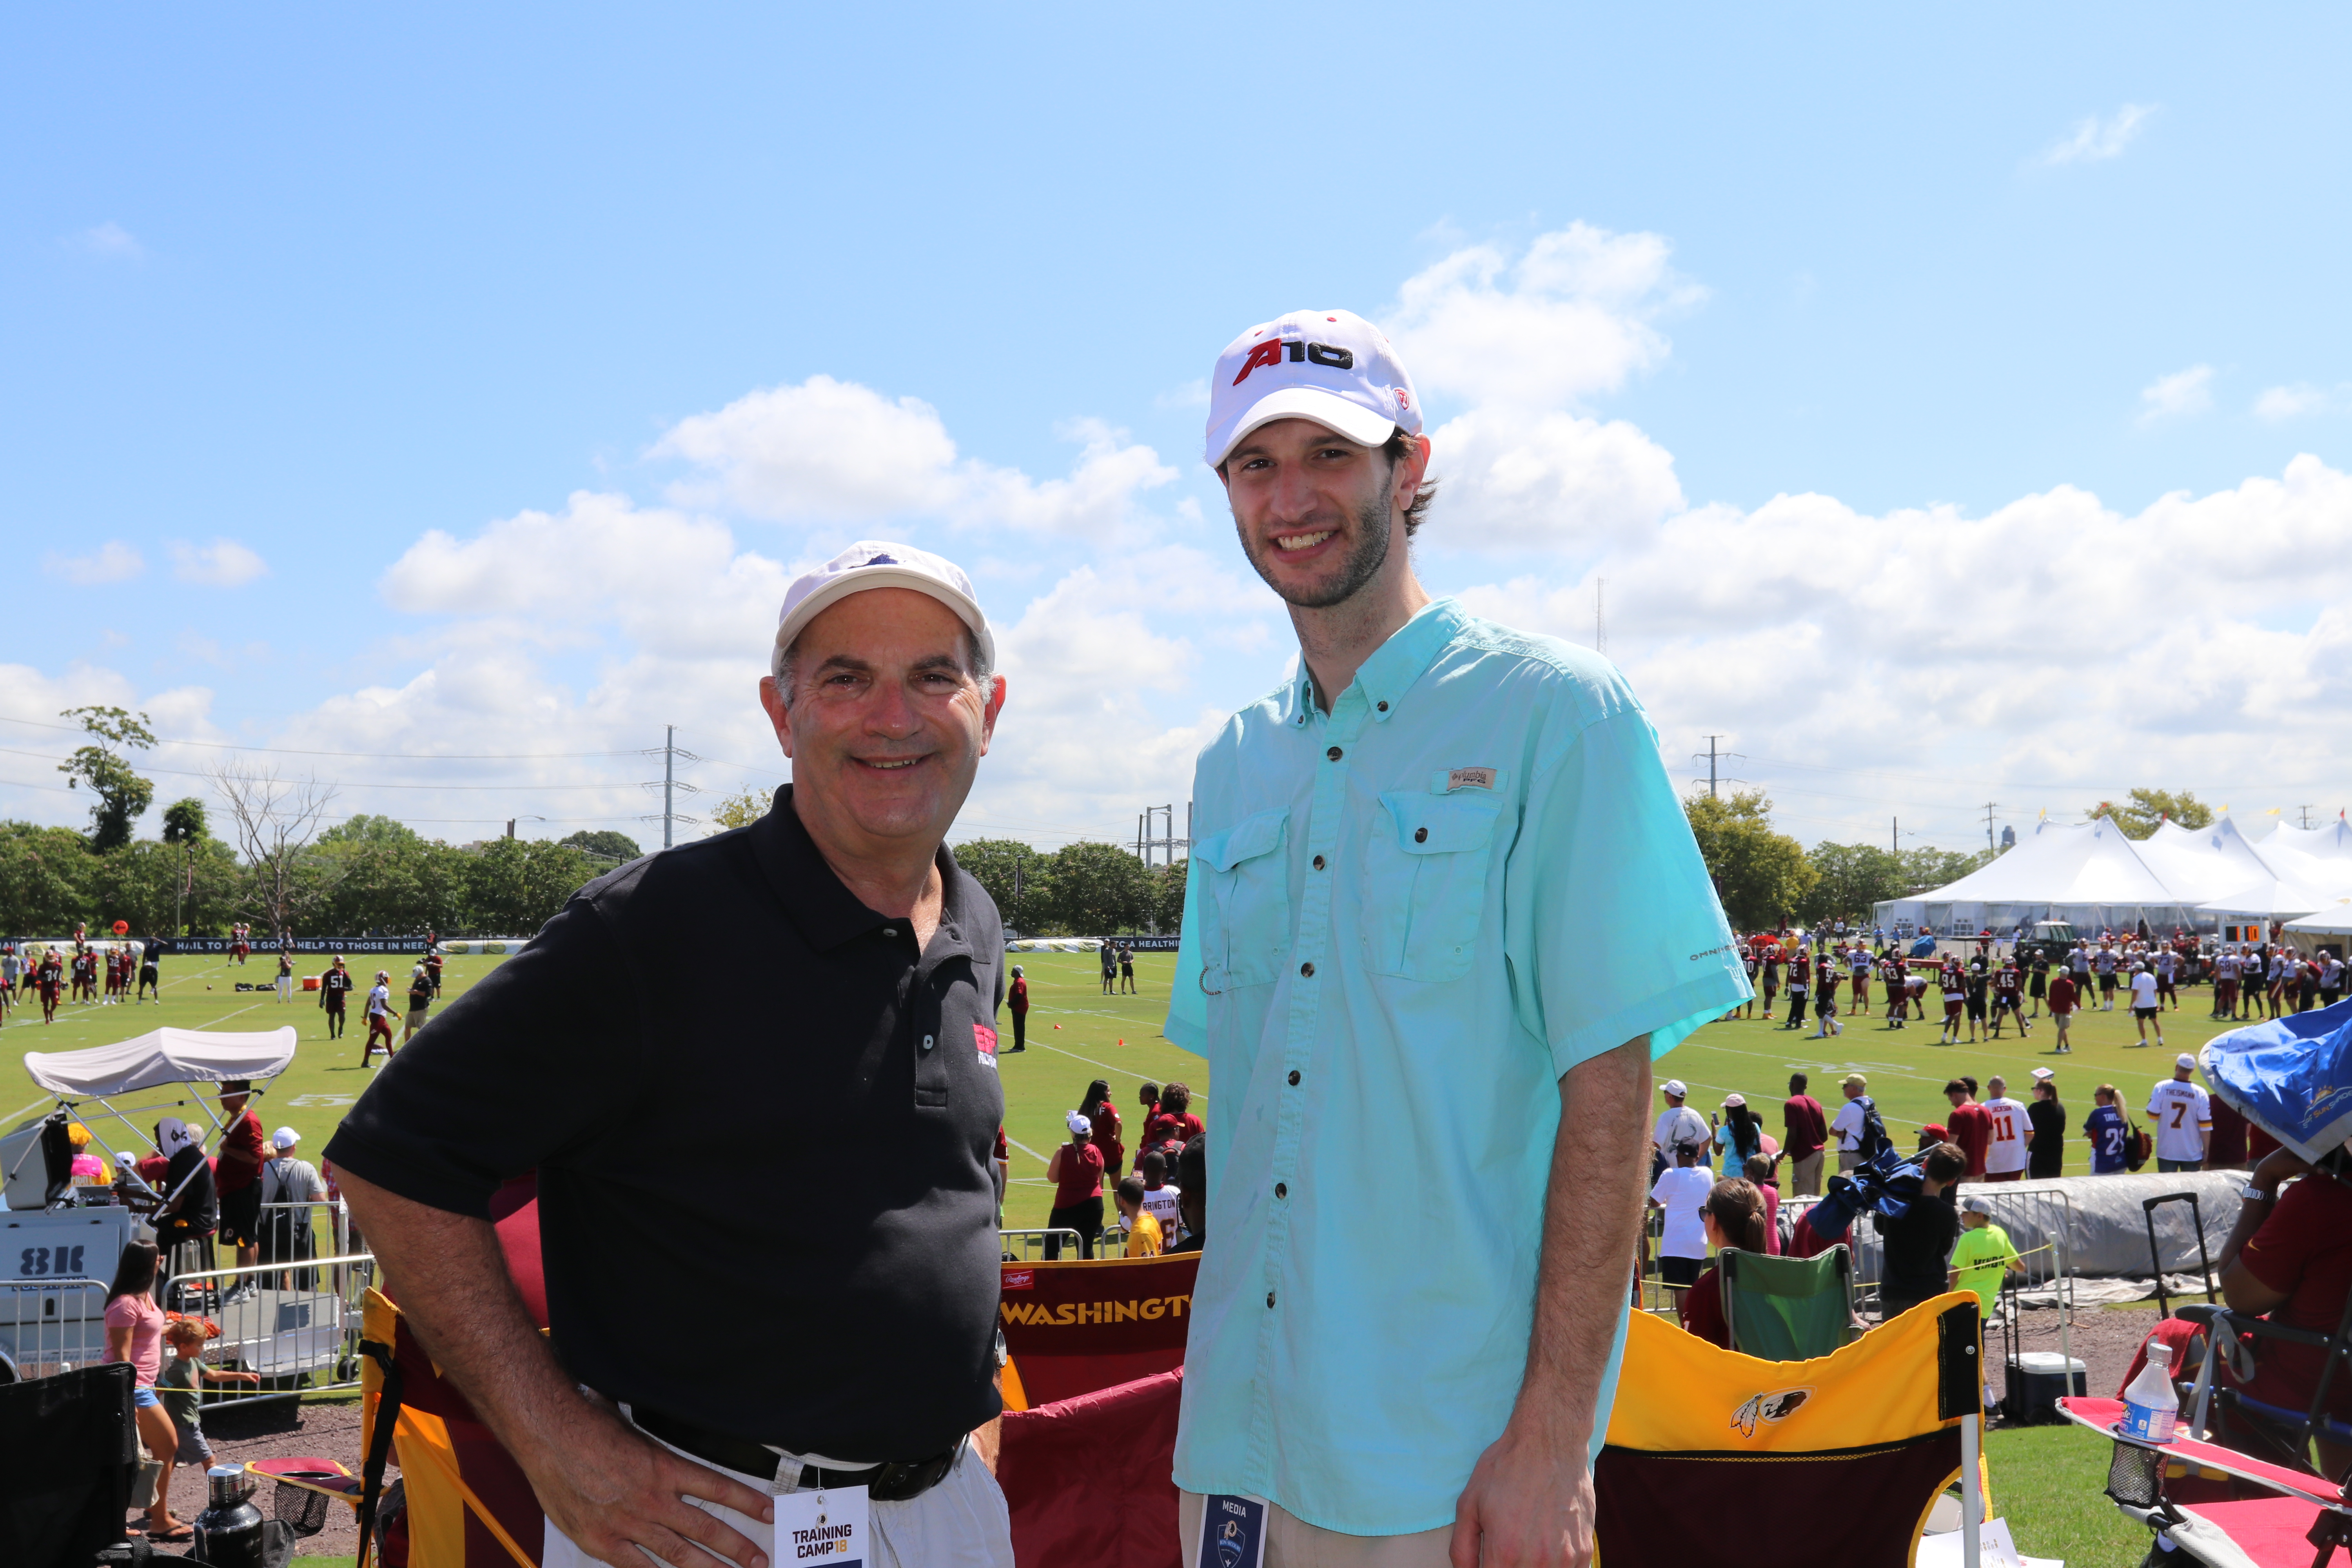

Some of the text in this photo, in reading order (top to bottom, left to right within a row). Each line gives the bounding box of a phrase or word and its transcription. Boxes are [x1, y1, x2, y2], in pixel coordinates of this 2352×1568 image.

[1232, 338, 1353, 386] A10
[347, 942, 384, 950] THOSE
[75, 960, 87, 970] 47
[1854, 954, 1867, 963] 63
[45, 969, 58, 982] 34
[1789, 962, 1798, 976] 72
[1886, 967, 1898, 980] 93
[330, 975, 343, 988] 51
[1942, 974, 1957, 988] 94
[2000, 974, 2014, 987] 45
[2103, 1113, 2121, 1122] TAYL
[2171, 1102, 2187, 1129] 7
[1994, 1116, 2015, 1142] 11
[1005, 1274, 1030, 1283] Rawlings
[1000, 1295, 1192, 1325] WASHINGT
[1222, 1500, 1246, 1518] MEDIA
[792, 1524, 852, 1544] TRAINING
